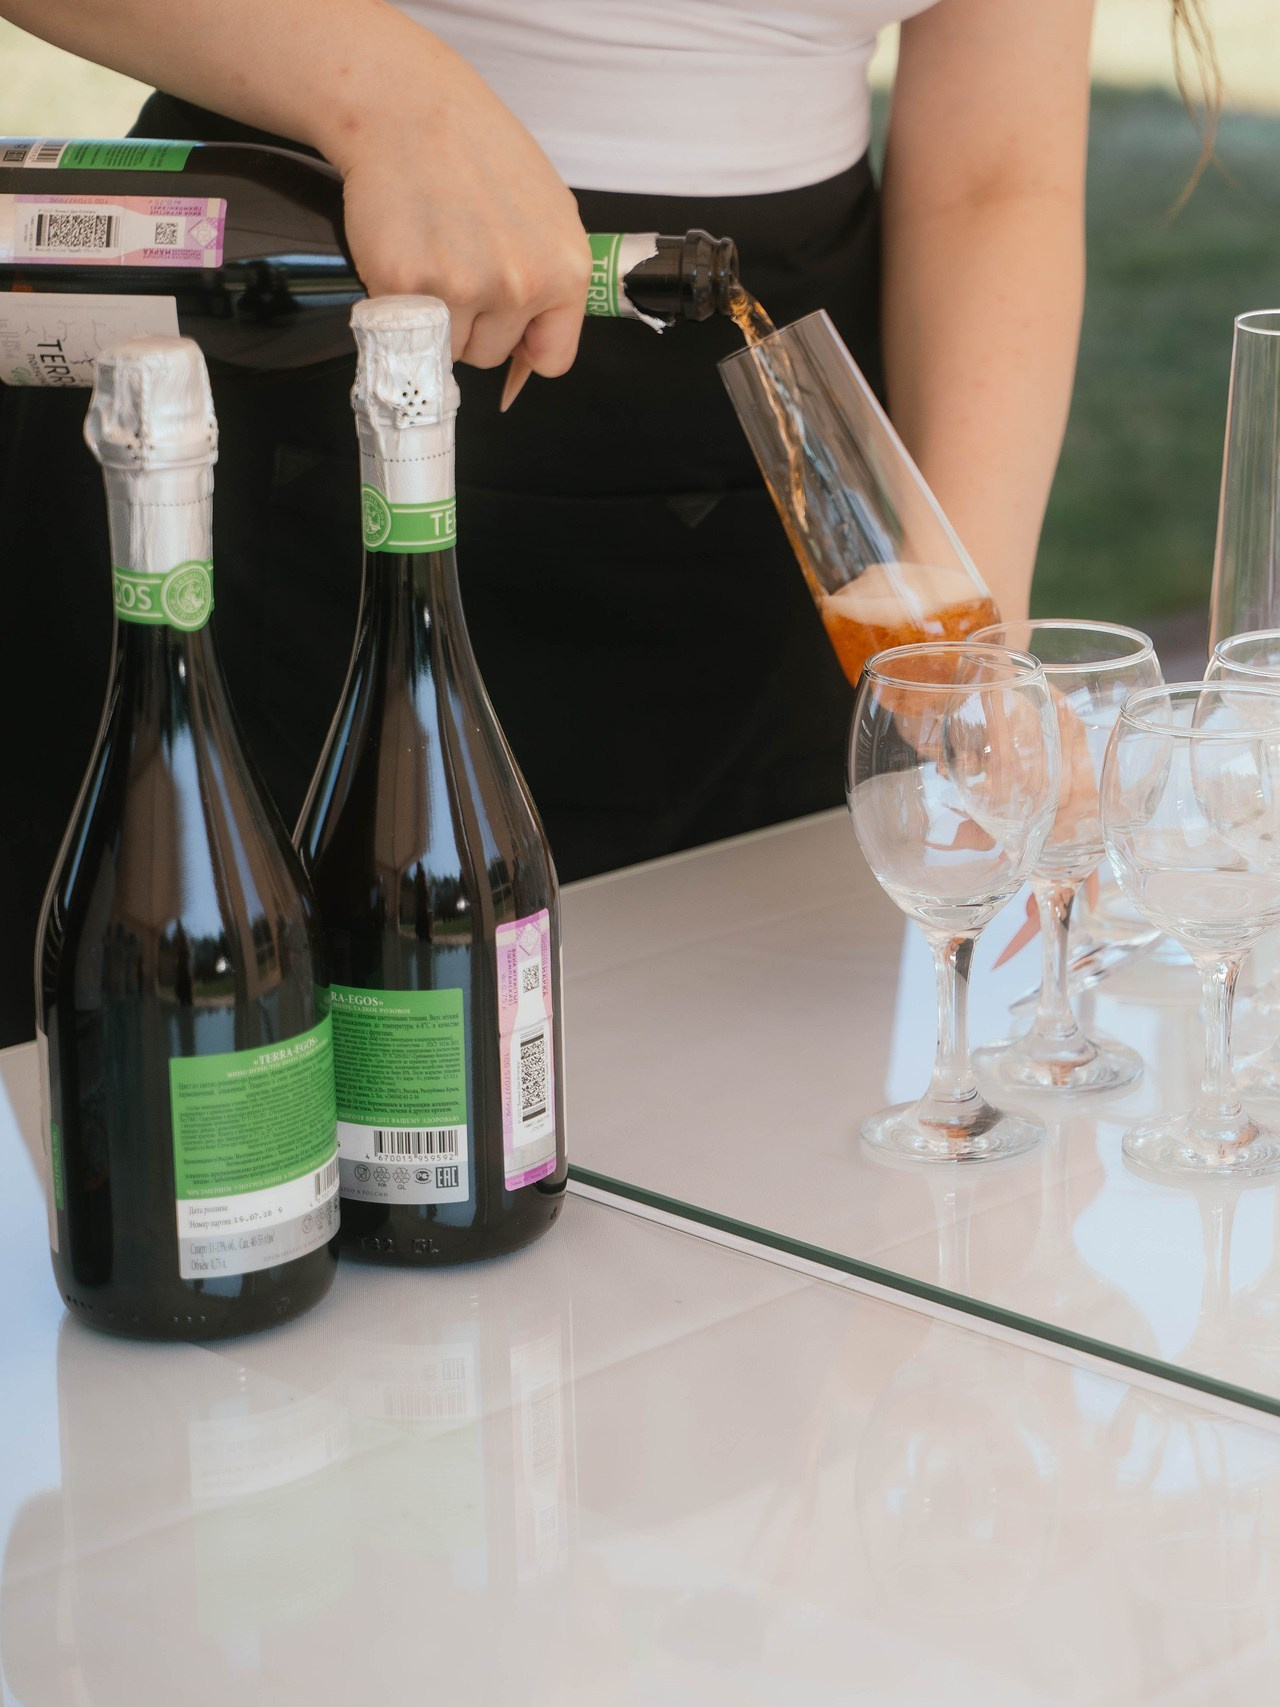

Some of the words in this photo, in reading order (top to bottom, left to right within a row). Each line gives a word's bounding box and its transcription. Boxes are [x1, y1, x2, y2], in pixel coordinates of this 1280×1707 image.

[587, 256, 609, 317] TERR
[37, 339, 77, 385] TERR
[429, 508, 457, 537] TE
[378, 1154, 414, 1162] 670015
[418, 1153, 455, 1161] 959592
